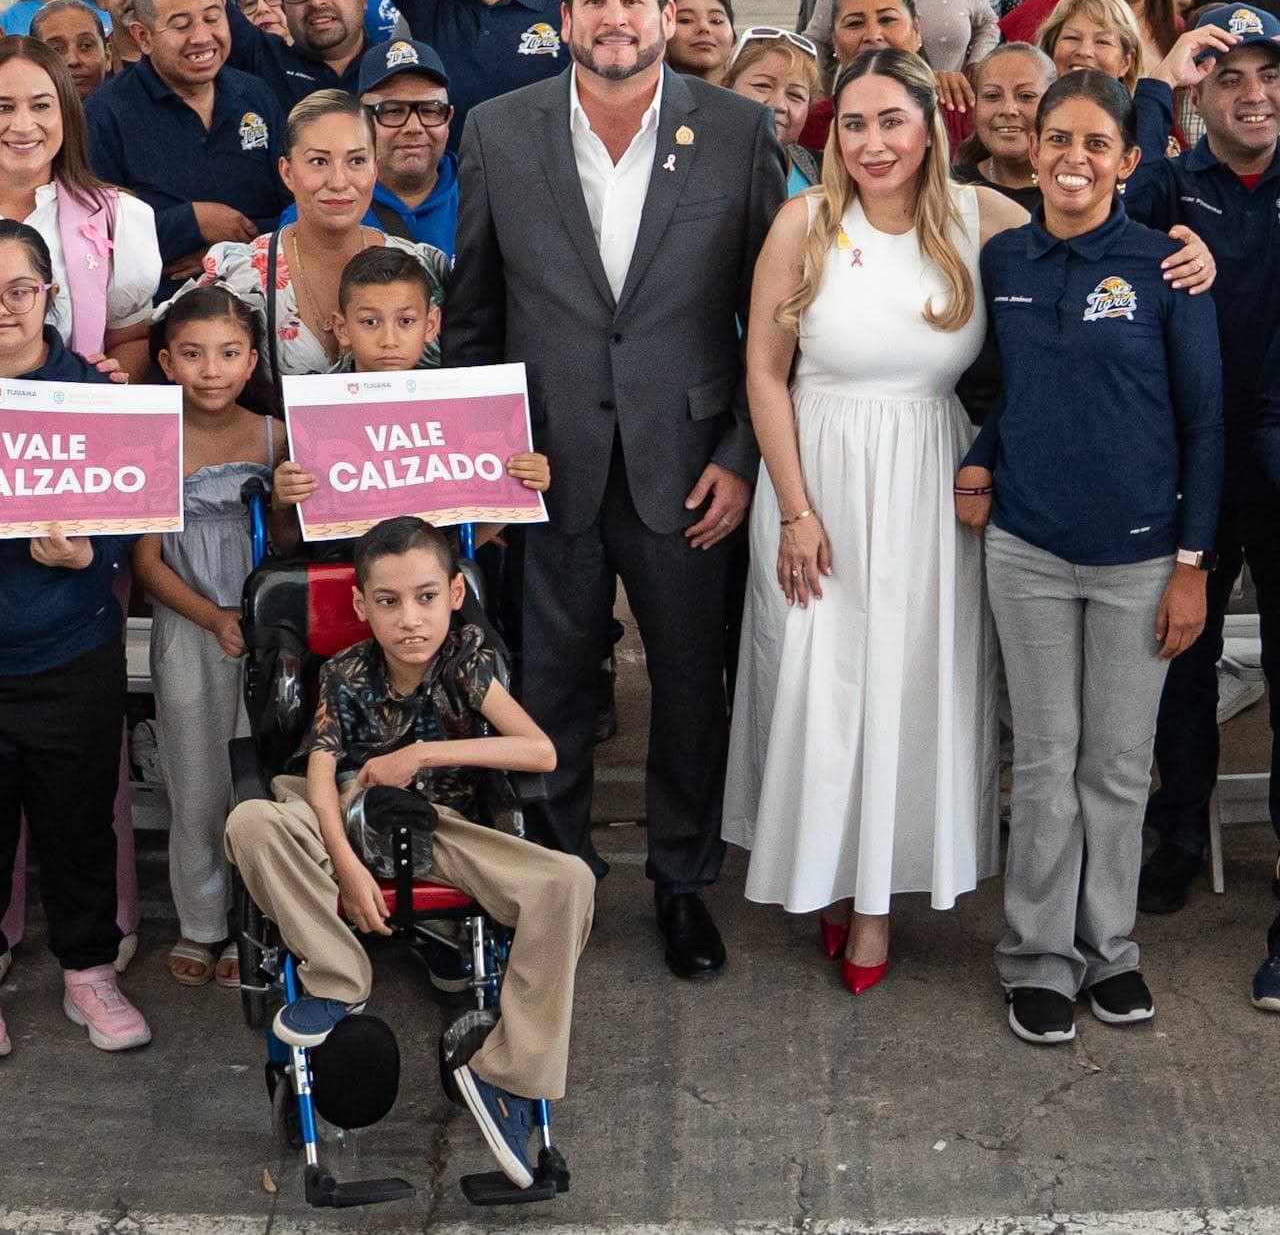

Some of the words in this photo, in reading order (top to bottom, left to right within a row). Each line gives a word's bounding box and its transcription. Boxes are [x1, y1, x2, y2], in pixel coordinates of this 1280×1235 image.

[6, 389, 37, 398] TIJUANA
[2, 432, 86, 461] VALE
[364, 421, 446, 452] VALE
[329, 453, 503, 492] CALZADO
